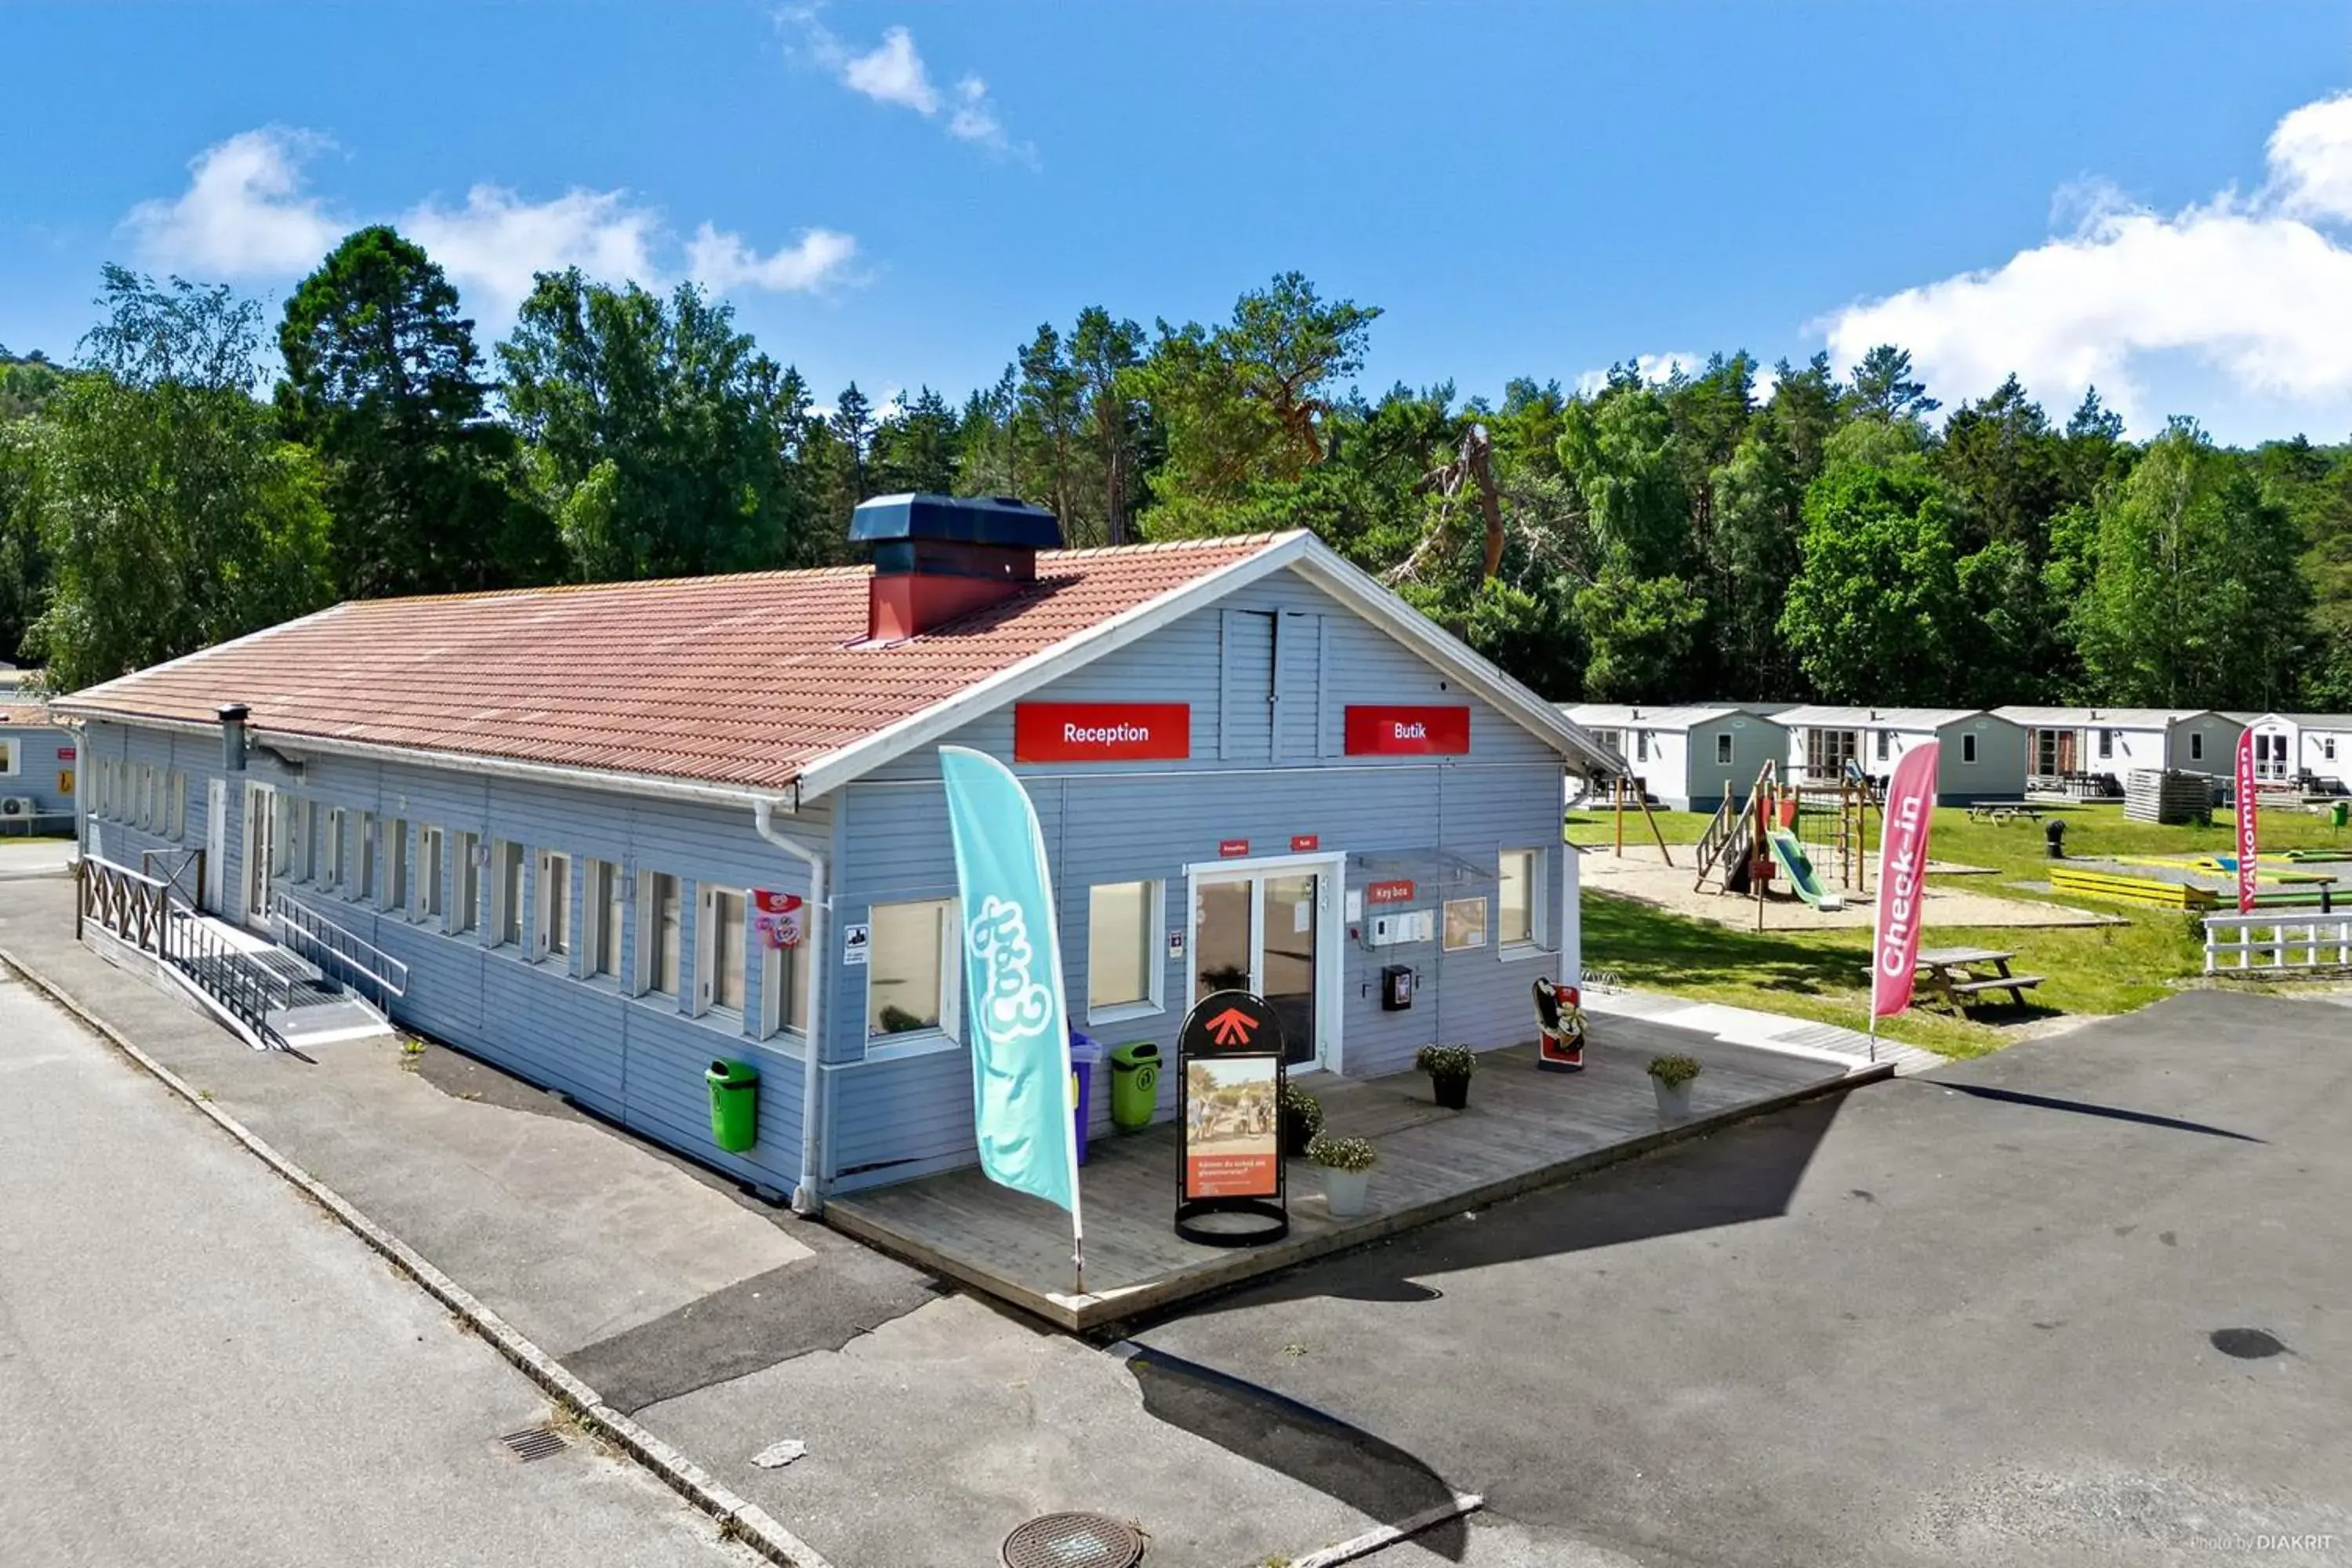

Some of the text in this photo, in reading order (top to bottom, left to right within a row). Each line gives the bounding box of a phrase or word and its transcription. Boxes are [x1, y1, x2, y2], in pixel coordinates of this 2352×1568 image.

[1064, 722, 1149, 746] Reception
[1395, 721, 1427, 739] Butik
[2240, 747, 2256, 902] Välkommen
[1882, 795, 1920, 977] Check-in
